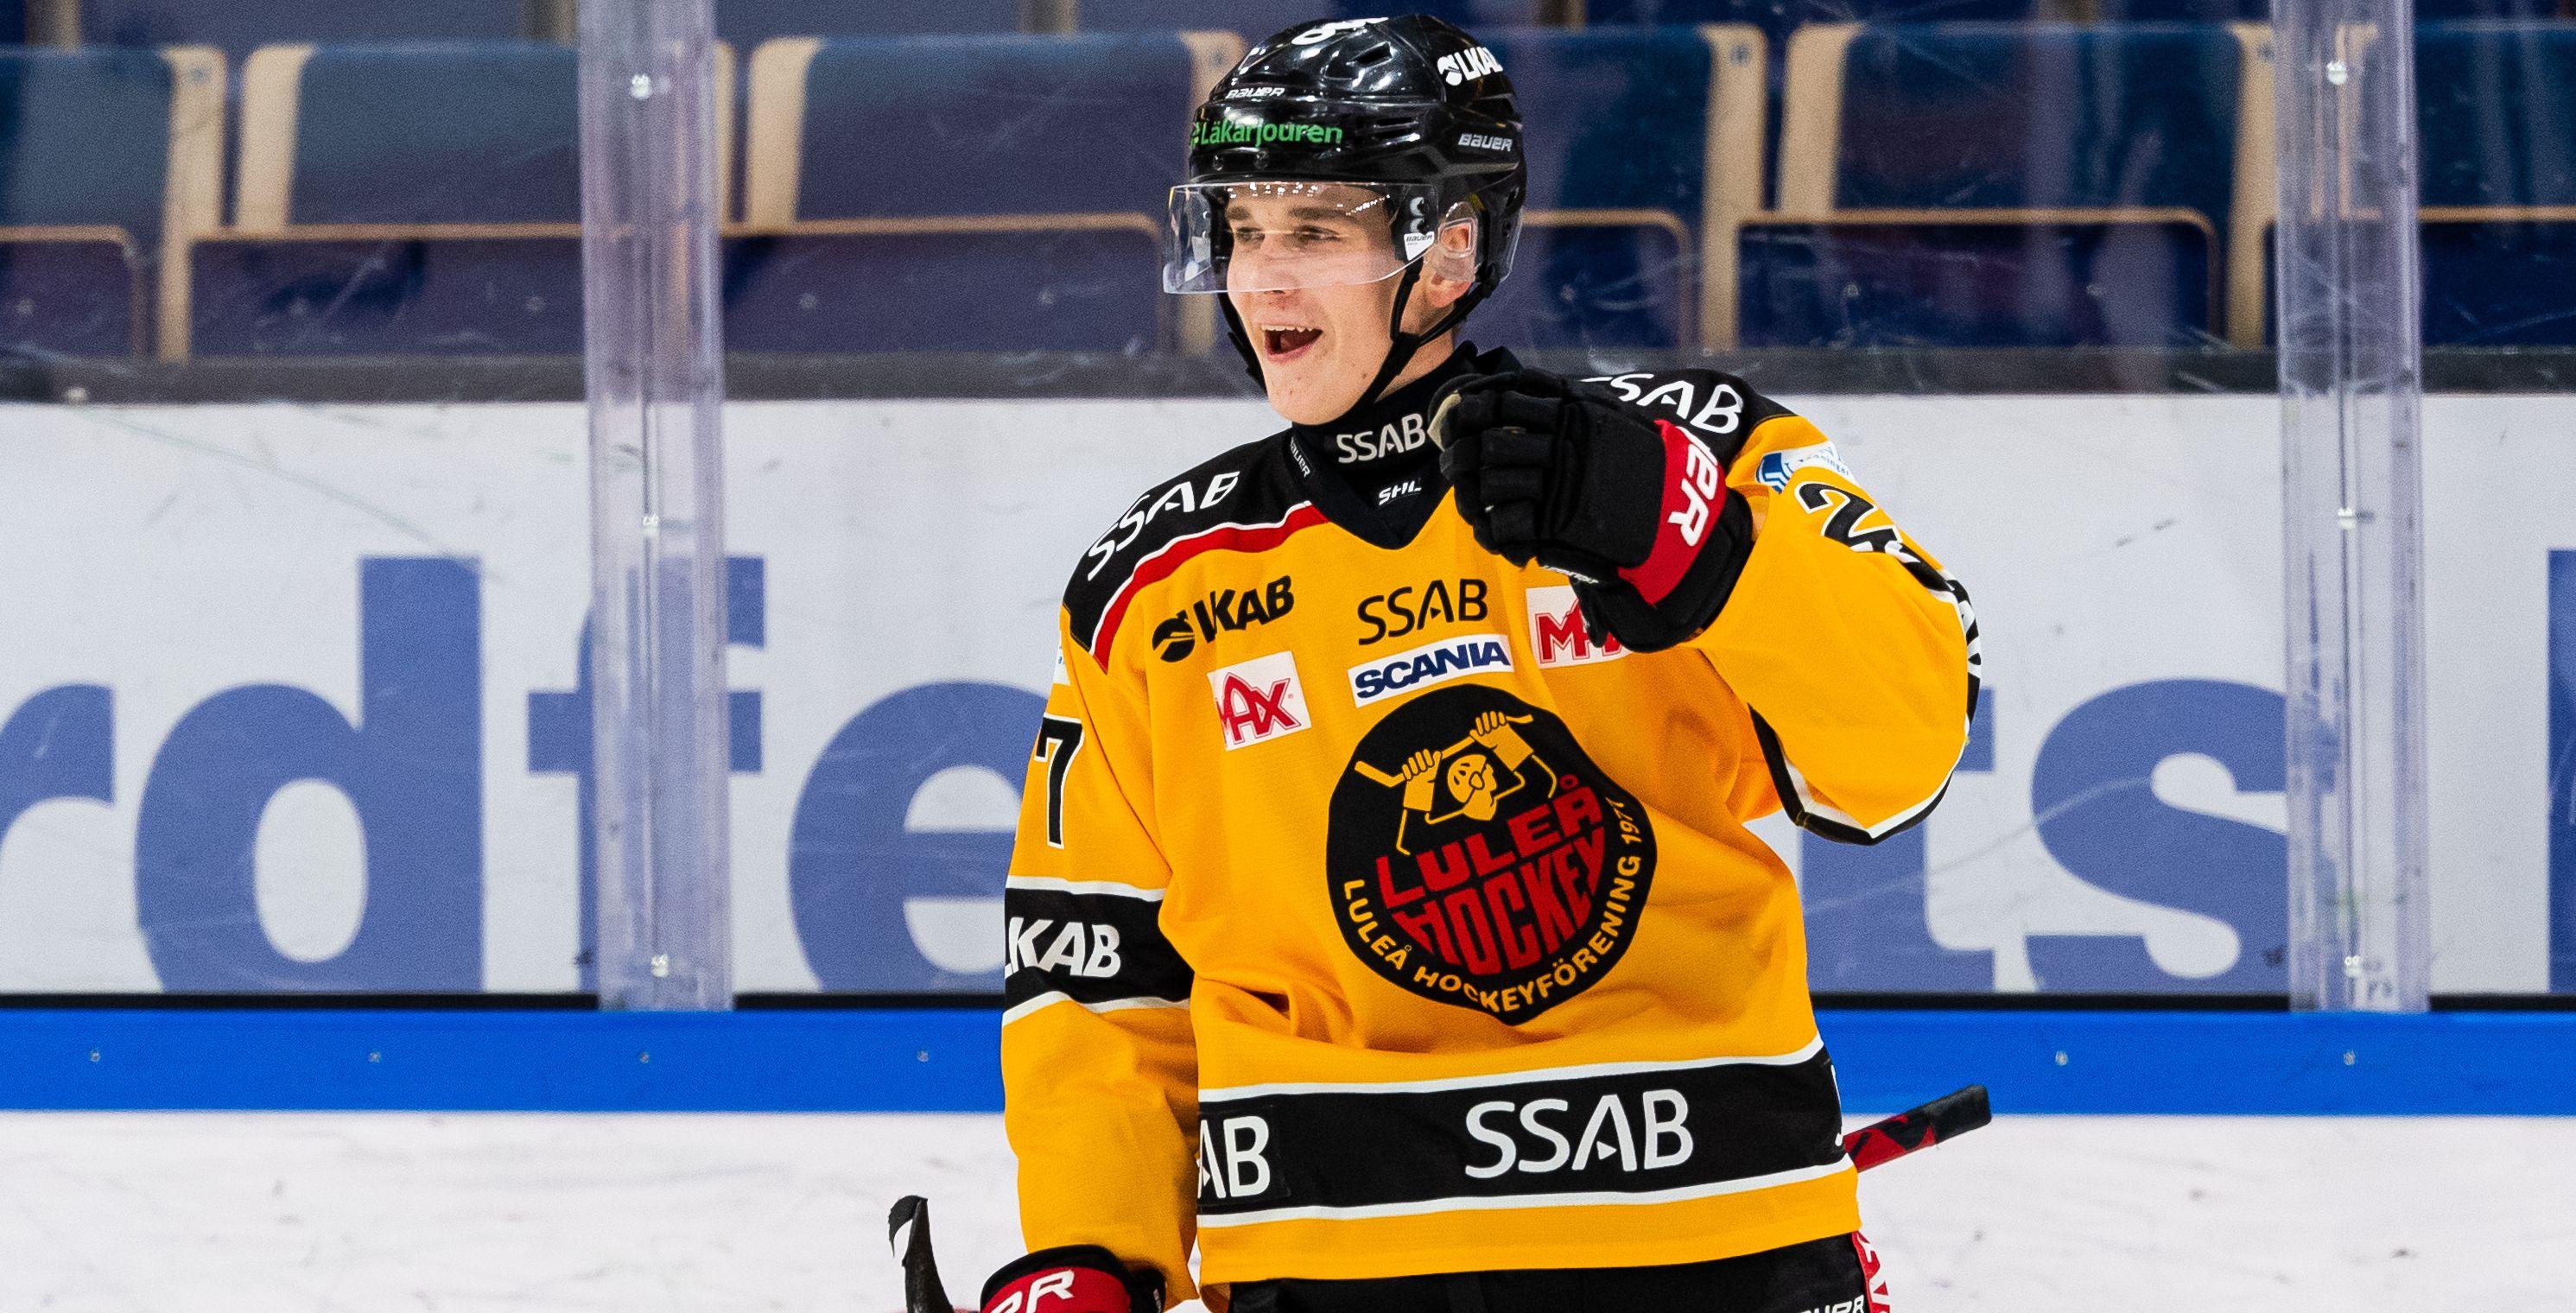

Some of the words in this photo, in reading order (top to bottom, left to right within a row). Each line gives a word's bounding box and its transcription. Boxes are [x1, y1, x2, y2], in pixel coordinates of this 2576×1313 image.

[1453, 46, 1504, 80] LKA
[1200, 117, 1343, 148] Läkarjouren
[1457, 132, 1513, 152] BAUER
[1579, 373, 1744, 434] SAB
[1336, 413, 1426, 464] SSAB
[1378, 480, 1423, 506] SHL
[1087, 471, 1240, 581] SSAB
[1357, 578, 1488, 646] SSAB
[1354, 640, 1512, 700] SCANIA
[1375, 773, 1603, 910] LULEÅ
[1391, 824, 1606, 977] HOCKEY
[1005, 916, 1122, 979] KAB
[1343, 879, 1413, 970] LULEÅ
[1413, 853, 1642, 1014] HOCKEYFÖRENING
[1464, 1088, 1694, 1179] SSAB
